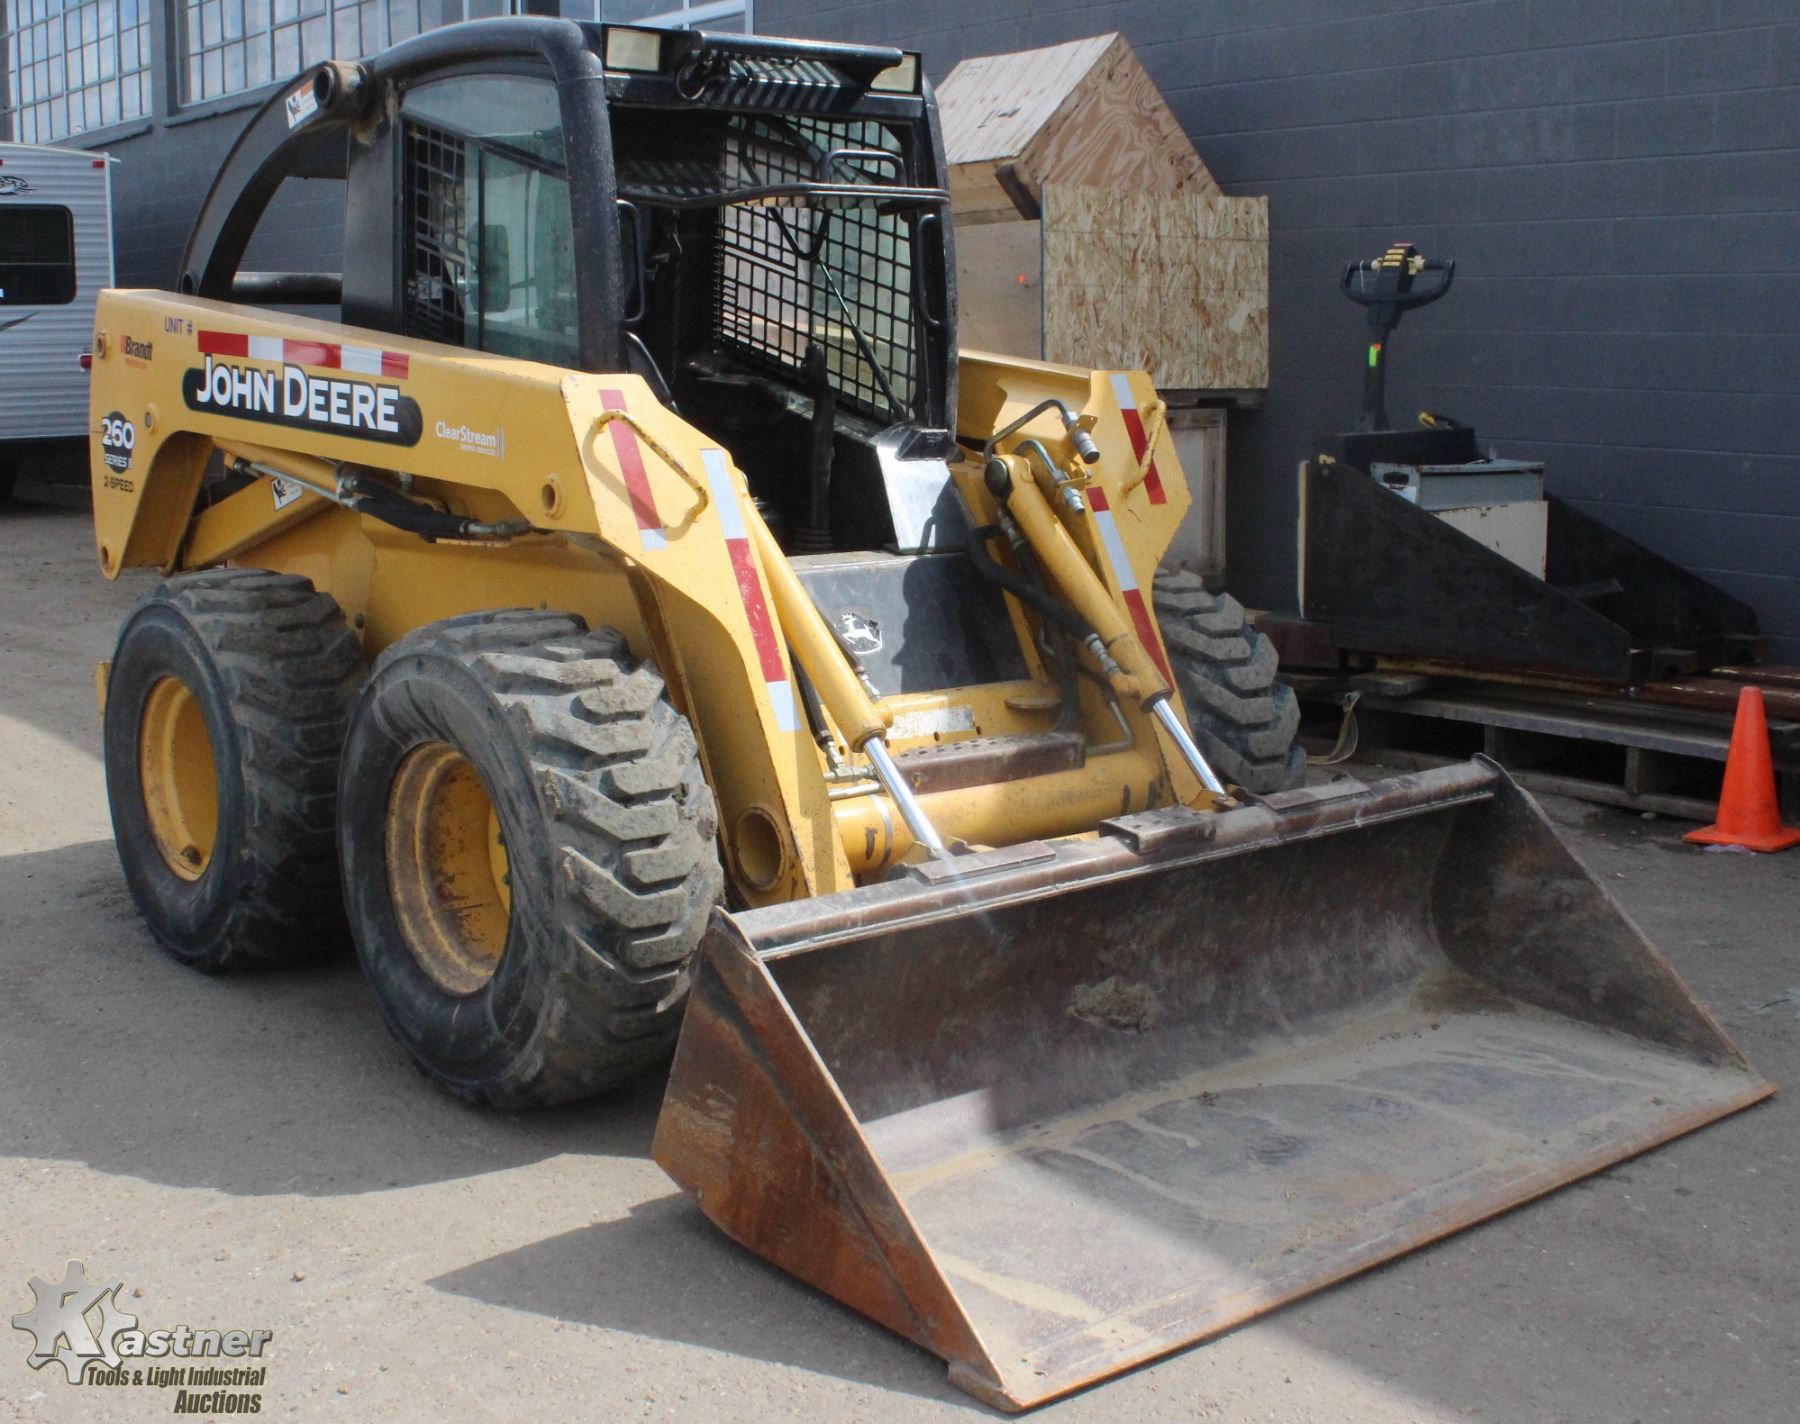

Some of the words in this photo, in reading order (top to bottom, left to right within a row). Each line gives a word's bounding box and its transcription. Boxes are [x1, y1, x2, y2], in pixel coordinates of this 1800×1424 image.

[165, 316, 183, 334] UNIT
[187, 320, 193, 336] #
[126, 335, 153, 361] Brandt
[197, 355, 275, 414] JOHN
[284, 365, 399, 433] DEERE
[101, 418, 136, 449] 260
[436, 421, 497, 448] ClearStream
[104, 453, 128, 468] SERIES
[104, 475, 134, 493] 2-SPEED
